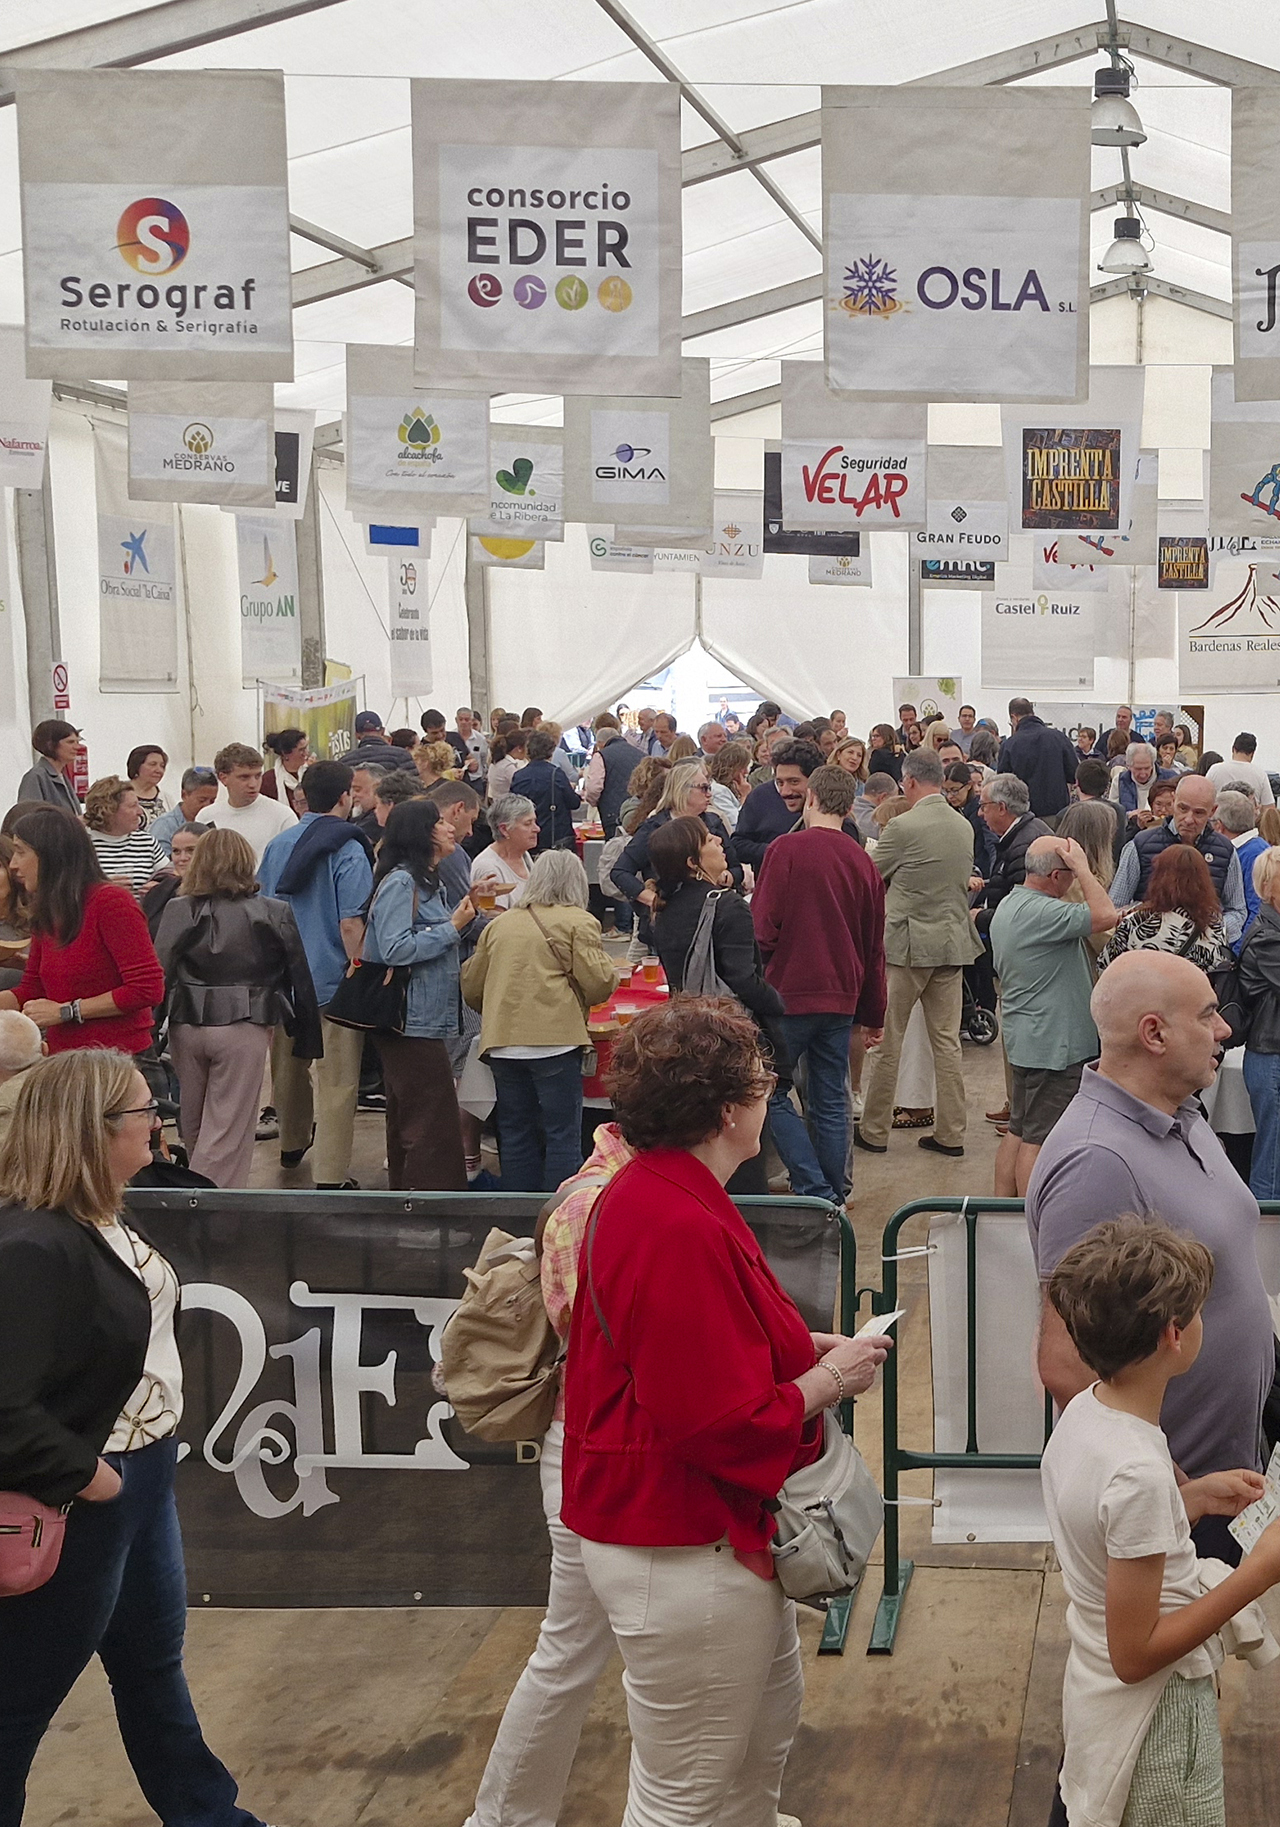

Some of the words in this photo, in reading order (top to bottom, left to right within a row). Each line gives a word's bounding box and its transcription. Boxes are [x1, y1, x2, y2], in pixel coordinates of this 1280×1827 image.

[466, 183, 632, 211] consorcio
[466, 217, 632, 268] EDER
[60, 277, 256, 316] Serograf
[916, 266, 1049, 312] OSLA
[1058, 301, 1077, 314] S.L.
[60, 316, 150, 333] Rotulación
[157, 319, 168, 333] &
[175, 319, 258, 337] Serigrafía
[398, 446, 443, 463] alcachofa
[163, 459, 235, 472] MEDRANO
[841, 455, 907, 472] Seguridad
[1026, 449, 1113, 480] IMPRENTA
[595, 466, 666, 481] GIMA
[1031, 480, 1109, 511] CASTILLA
[491, 501, 556, 513] ncomunidad
[500, 511, 511, 521] La
[514, 511, 548, 522] Ribera
[917, 531, 954, 544] GRAN
[959, 532, 1001, 545] FEUDO
[654, 553, 700, 561] YUNTAMIEN
[1160, 547, 1206, 563] IMPRENTA
[826, 569, 861, 577] MEDRANO
[1163, 563, 1204, 579] CASTILLA
[101, 580, 119, 596] Obra
[240, 595, 273, 623] Grupo
[276, 595, 295, 617] AN
[995, 603, 1035, 614] Castel
[1051, 603, 1080, 615] Ruiz
[1189, 641, 1241, 652] Bardenas
